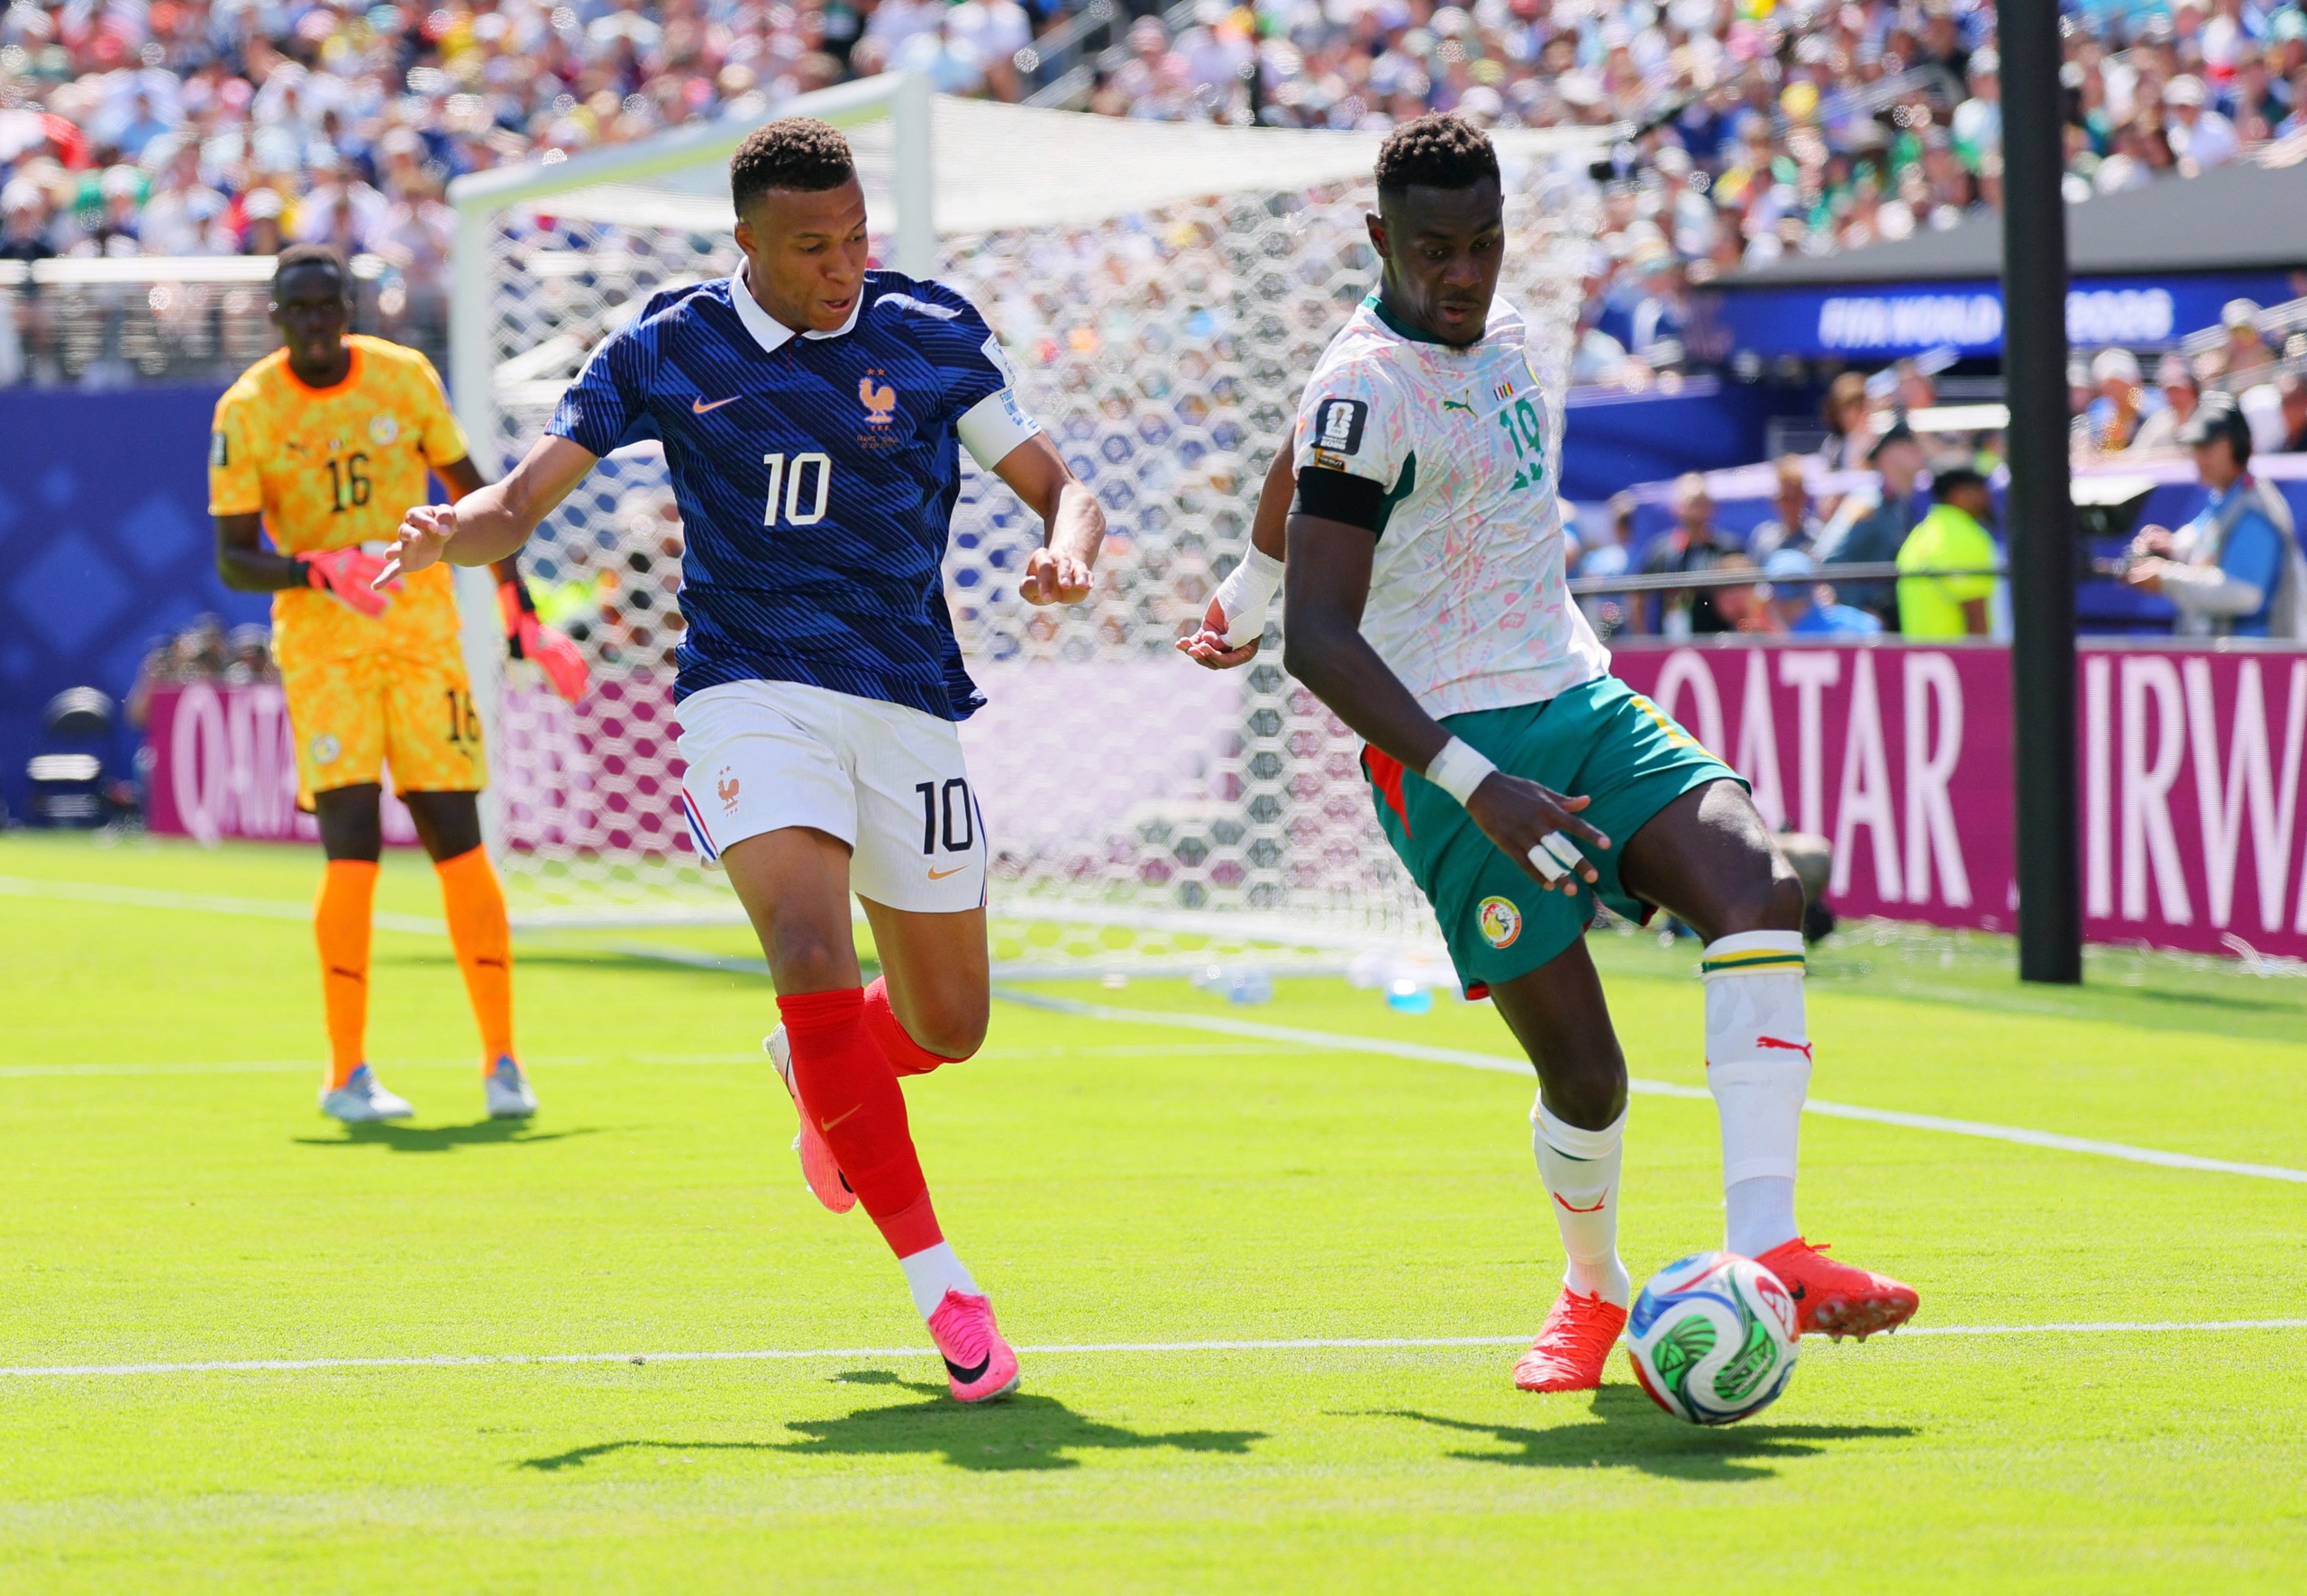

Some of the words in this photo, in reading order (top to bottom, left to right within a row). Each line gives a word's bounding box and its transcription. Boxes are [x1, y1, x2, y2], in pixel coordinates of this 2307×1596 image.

[1891, 294, 2003, 346] WORLD
[2065, 287, 2174, 342] 2026
[1499, 397, 1545, 491] 19
[326, 452, 371, 514] 16
[763, 452, 832, 526] 10
[916, 777, 973, 855] 10
